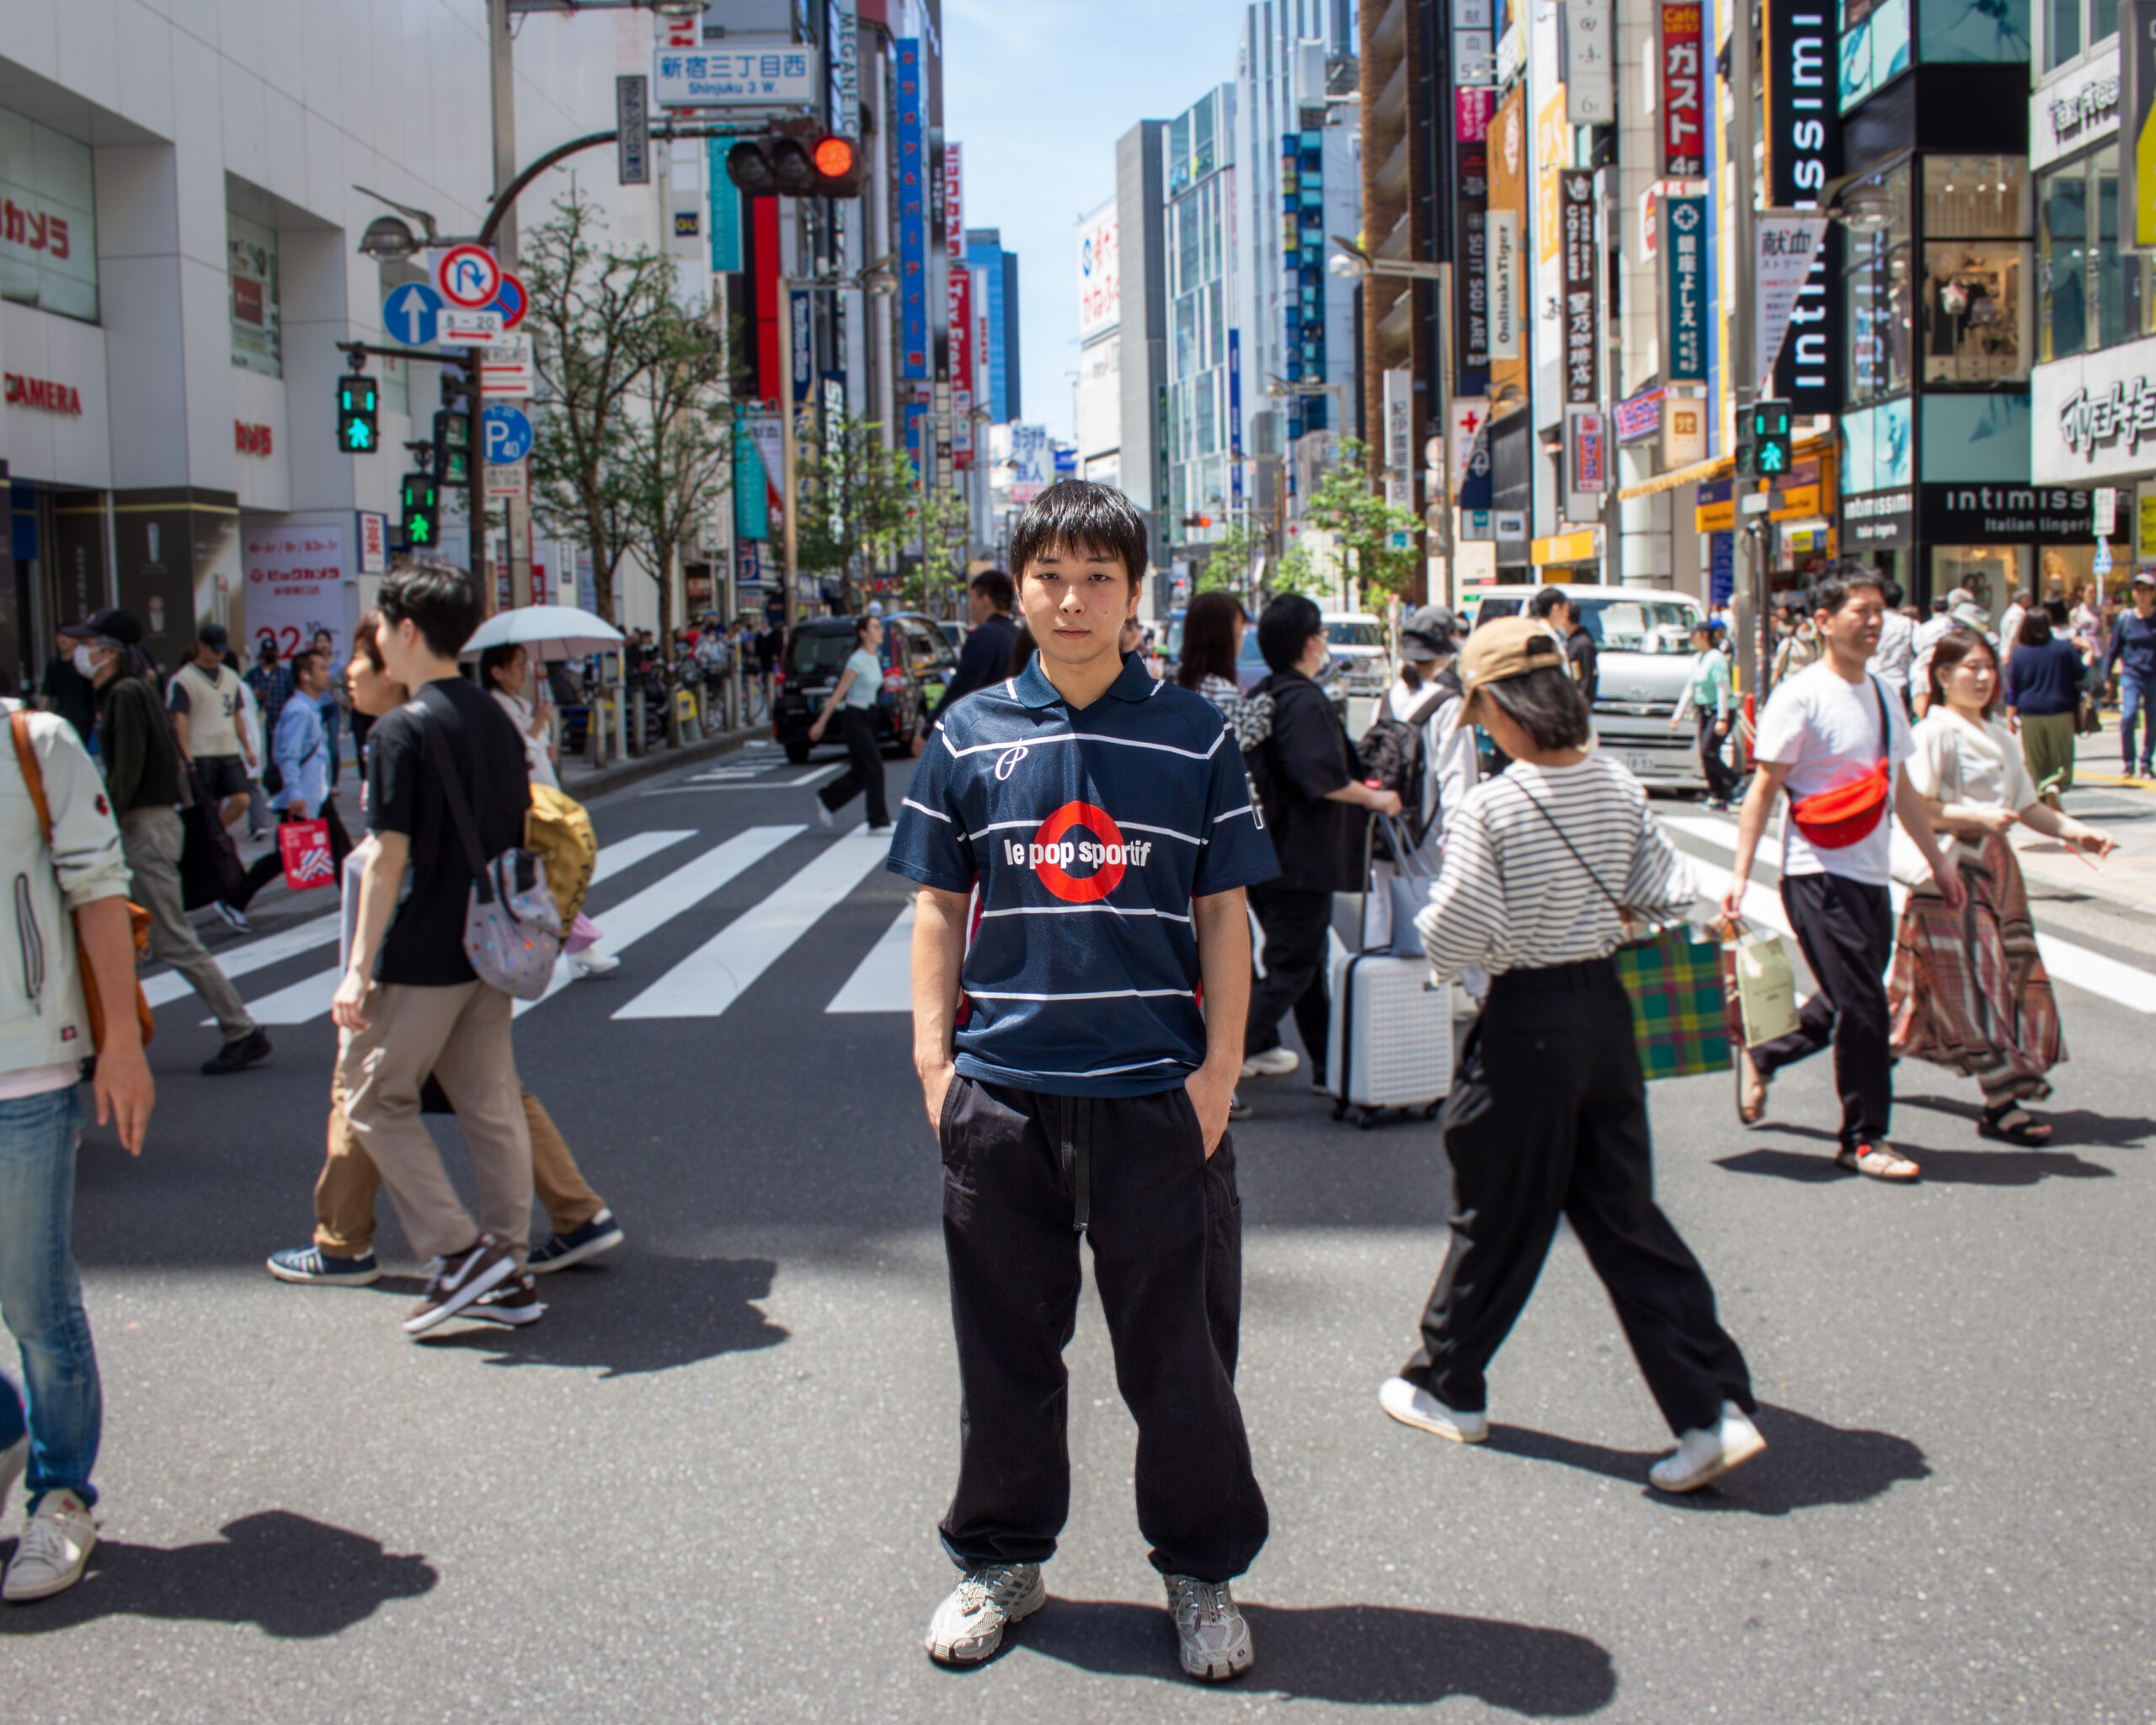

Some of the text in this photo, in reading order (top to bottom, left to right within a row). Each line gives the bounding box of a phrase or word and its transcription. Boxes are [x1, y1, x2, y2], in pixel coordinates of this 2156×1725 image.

[660, 54, 807, 80] 新宿三丁目西
[841, 13, 857, 101] MEGANE
[688, 82, 779, 96] Shinjuku 3 W.
[1666, 41, 1699, 147] ガスト
[2048, 76, 2120, 131] Tax Free
[1669, 155, 1699, 175] 4F
[1791, 14, 1827, 387] intiissimi
[0, 197, 70, 260] カメラ
[675, 217, 699, 234] GU
[1566, 205, 1580, 281] COFFEE
[1761, 228, 1811, 256] 献血
[1468, 233, 1486, 350] SUIT SQUARE
[1496, 225, 1512, 344] Onitsuka Tiger
[1567, 291, 1592, 387] 星乃珈琲店
[4, 372, 82, 416] CAMERA
[1572, 389, 1589, 401] 2F
[235, 419, 273, 457] カメラ
[486, 420, 510, 458] P
[502, 441, 520, 458] 40
[1391, 401, 1408, 499] 紀伊國屋書店
[1984, 515, 2093, 536] Italian lingeri
[1003, 839, 1152, 870] le pop sportif
